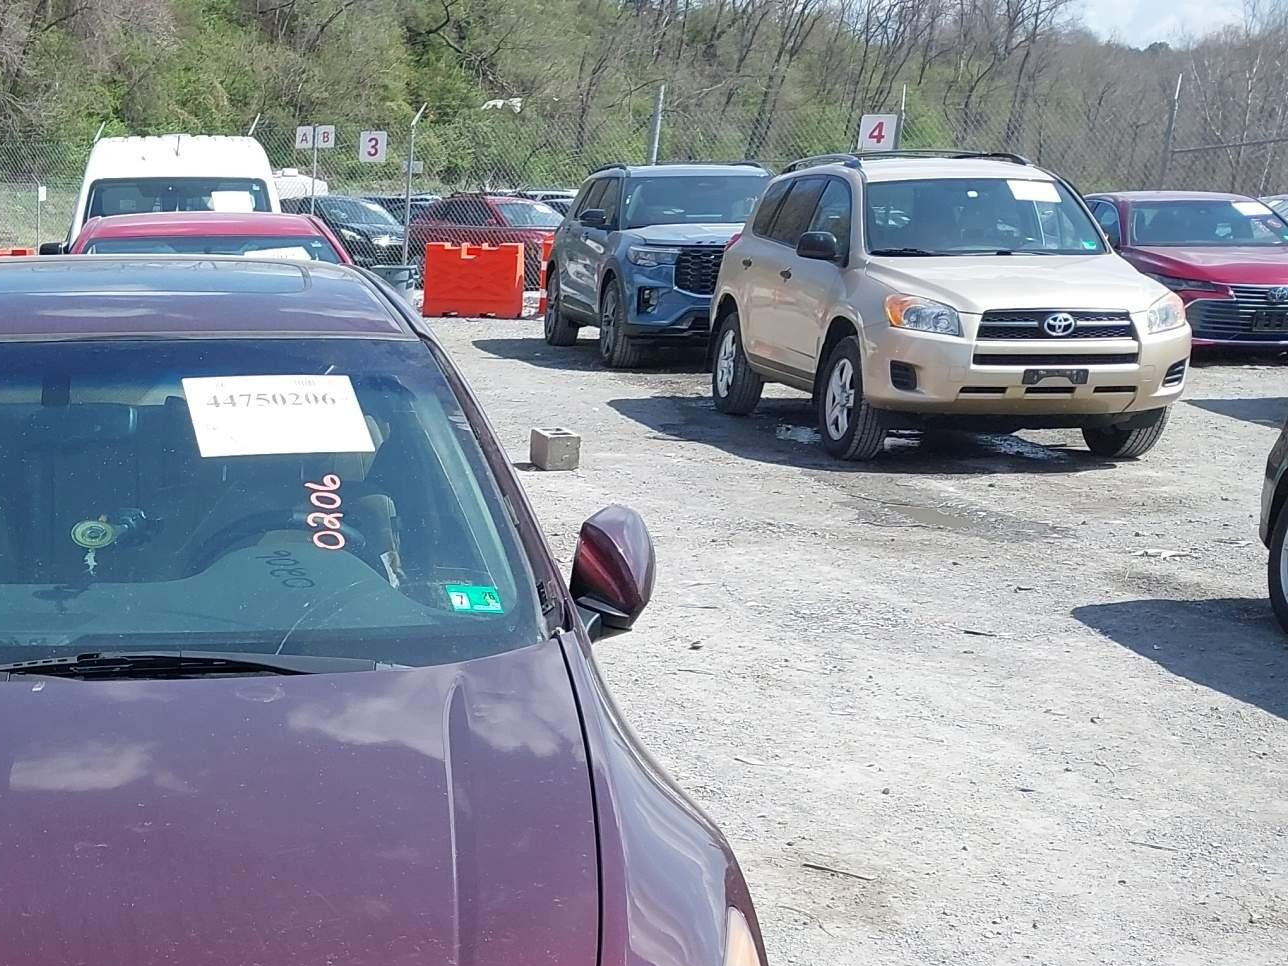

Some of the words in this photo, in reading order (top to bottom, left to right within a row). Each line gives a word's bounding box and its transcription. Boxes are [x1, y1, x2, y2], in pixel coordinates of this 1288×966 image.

[300, 132, 309, 144] A
[322, 131, 330, 143] B
[868, 121, 885, 144] 4
[367, 137, 379, 157] 3
[206, 391, 337, 409] 44750206
[303, 473, 346, 550] 0206
